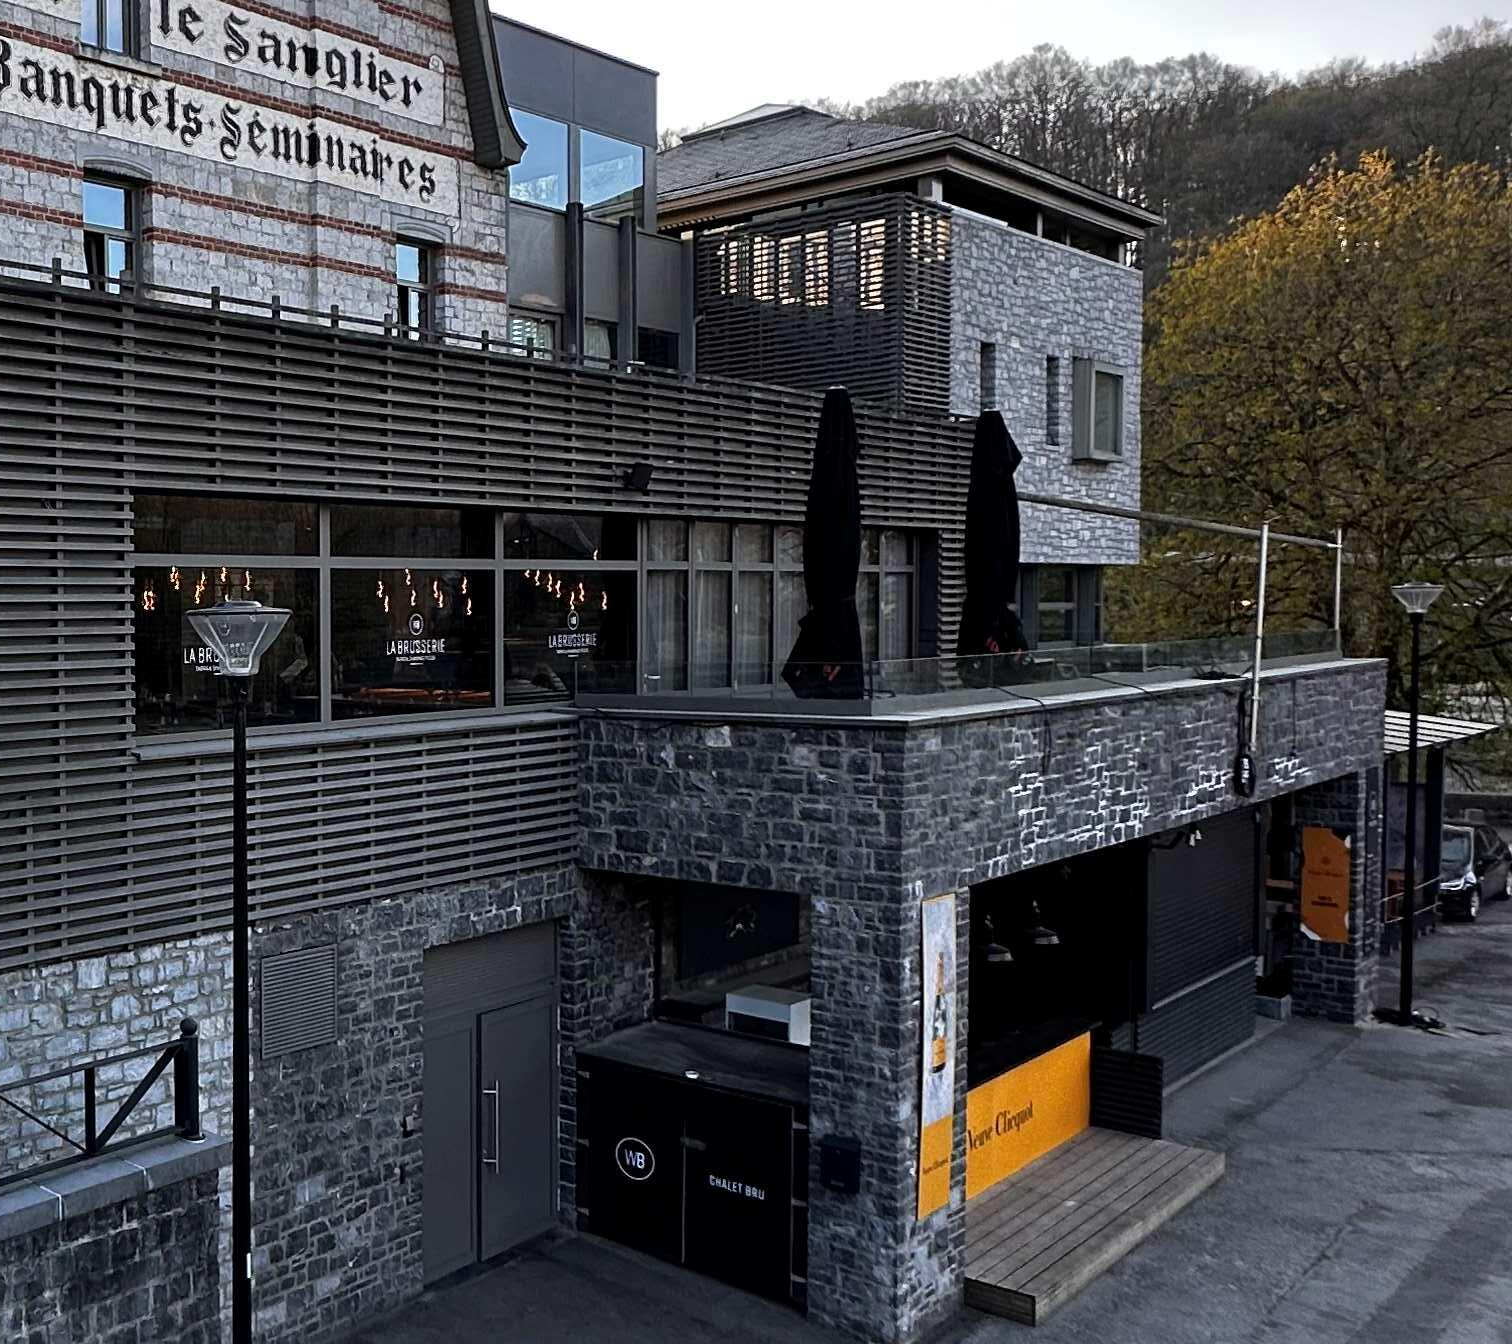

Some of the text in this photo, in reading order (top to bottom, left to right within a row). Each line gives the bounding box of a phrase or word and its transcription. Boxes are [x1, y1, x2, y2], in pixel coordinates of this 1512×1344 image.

[222, 11, 423, 109] Sanglier
[183, 647, 196, 664] LA
[624, 1149, 765, 1200] WB CHALET BRU
